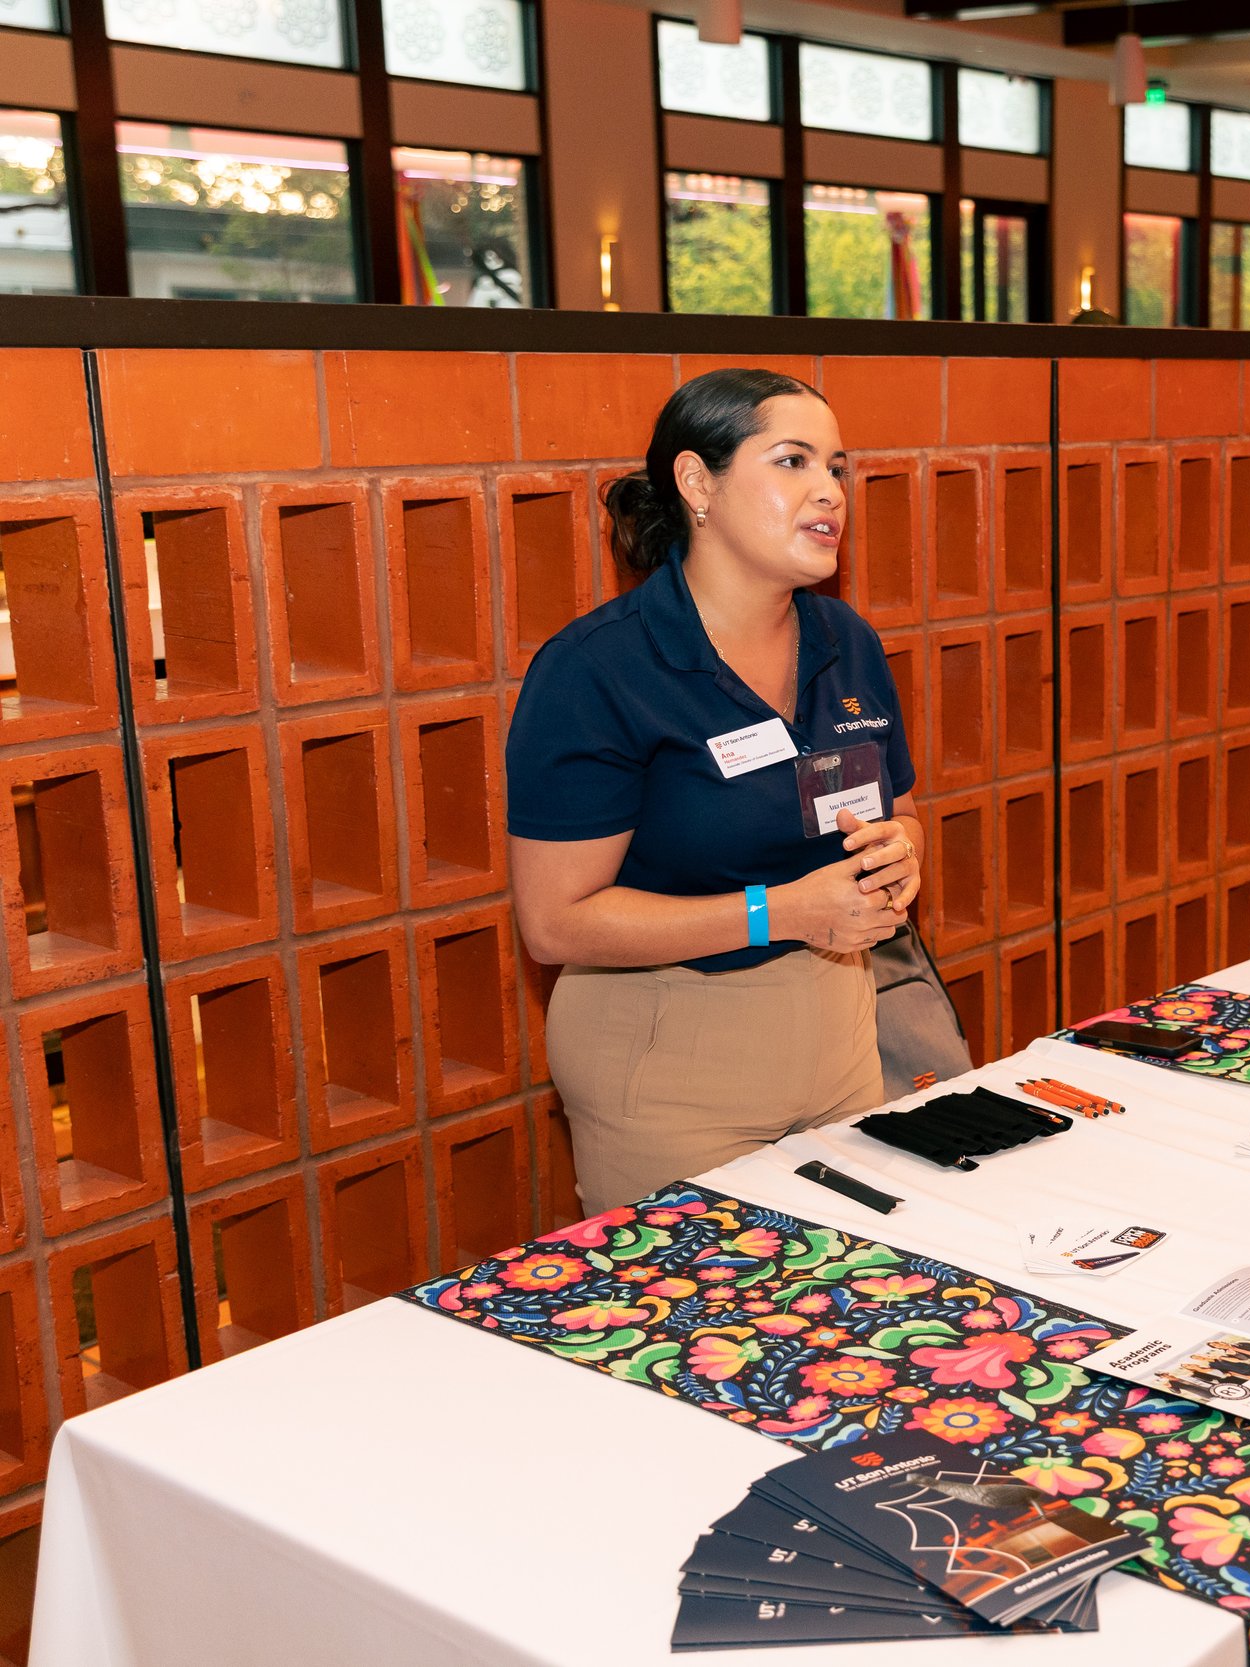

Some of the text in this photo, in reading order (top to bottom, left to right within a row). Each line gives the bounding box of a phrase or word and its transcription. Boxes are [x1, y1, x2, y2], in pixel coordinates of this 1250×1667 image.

[834, 717, 888, 733] UT San Antonio
[740, 732, 758, 741] Antonio
[724, 755, 747, 764] Hernandez
[840, 796, 868, 807] Hernandez
[1109, 1340, 1162, 1368] Academic
[1118, 1344, 1171, 1371] Programs
[1220, 1386, 1240, 1396] R1
[835, 1455, 936, 1489] UT San Antonio
